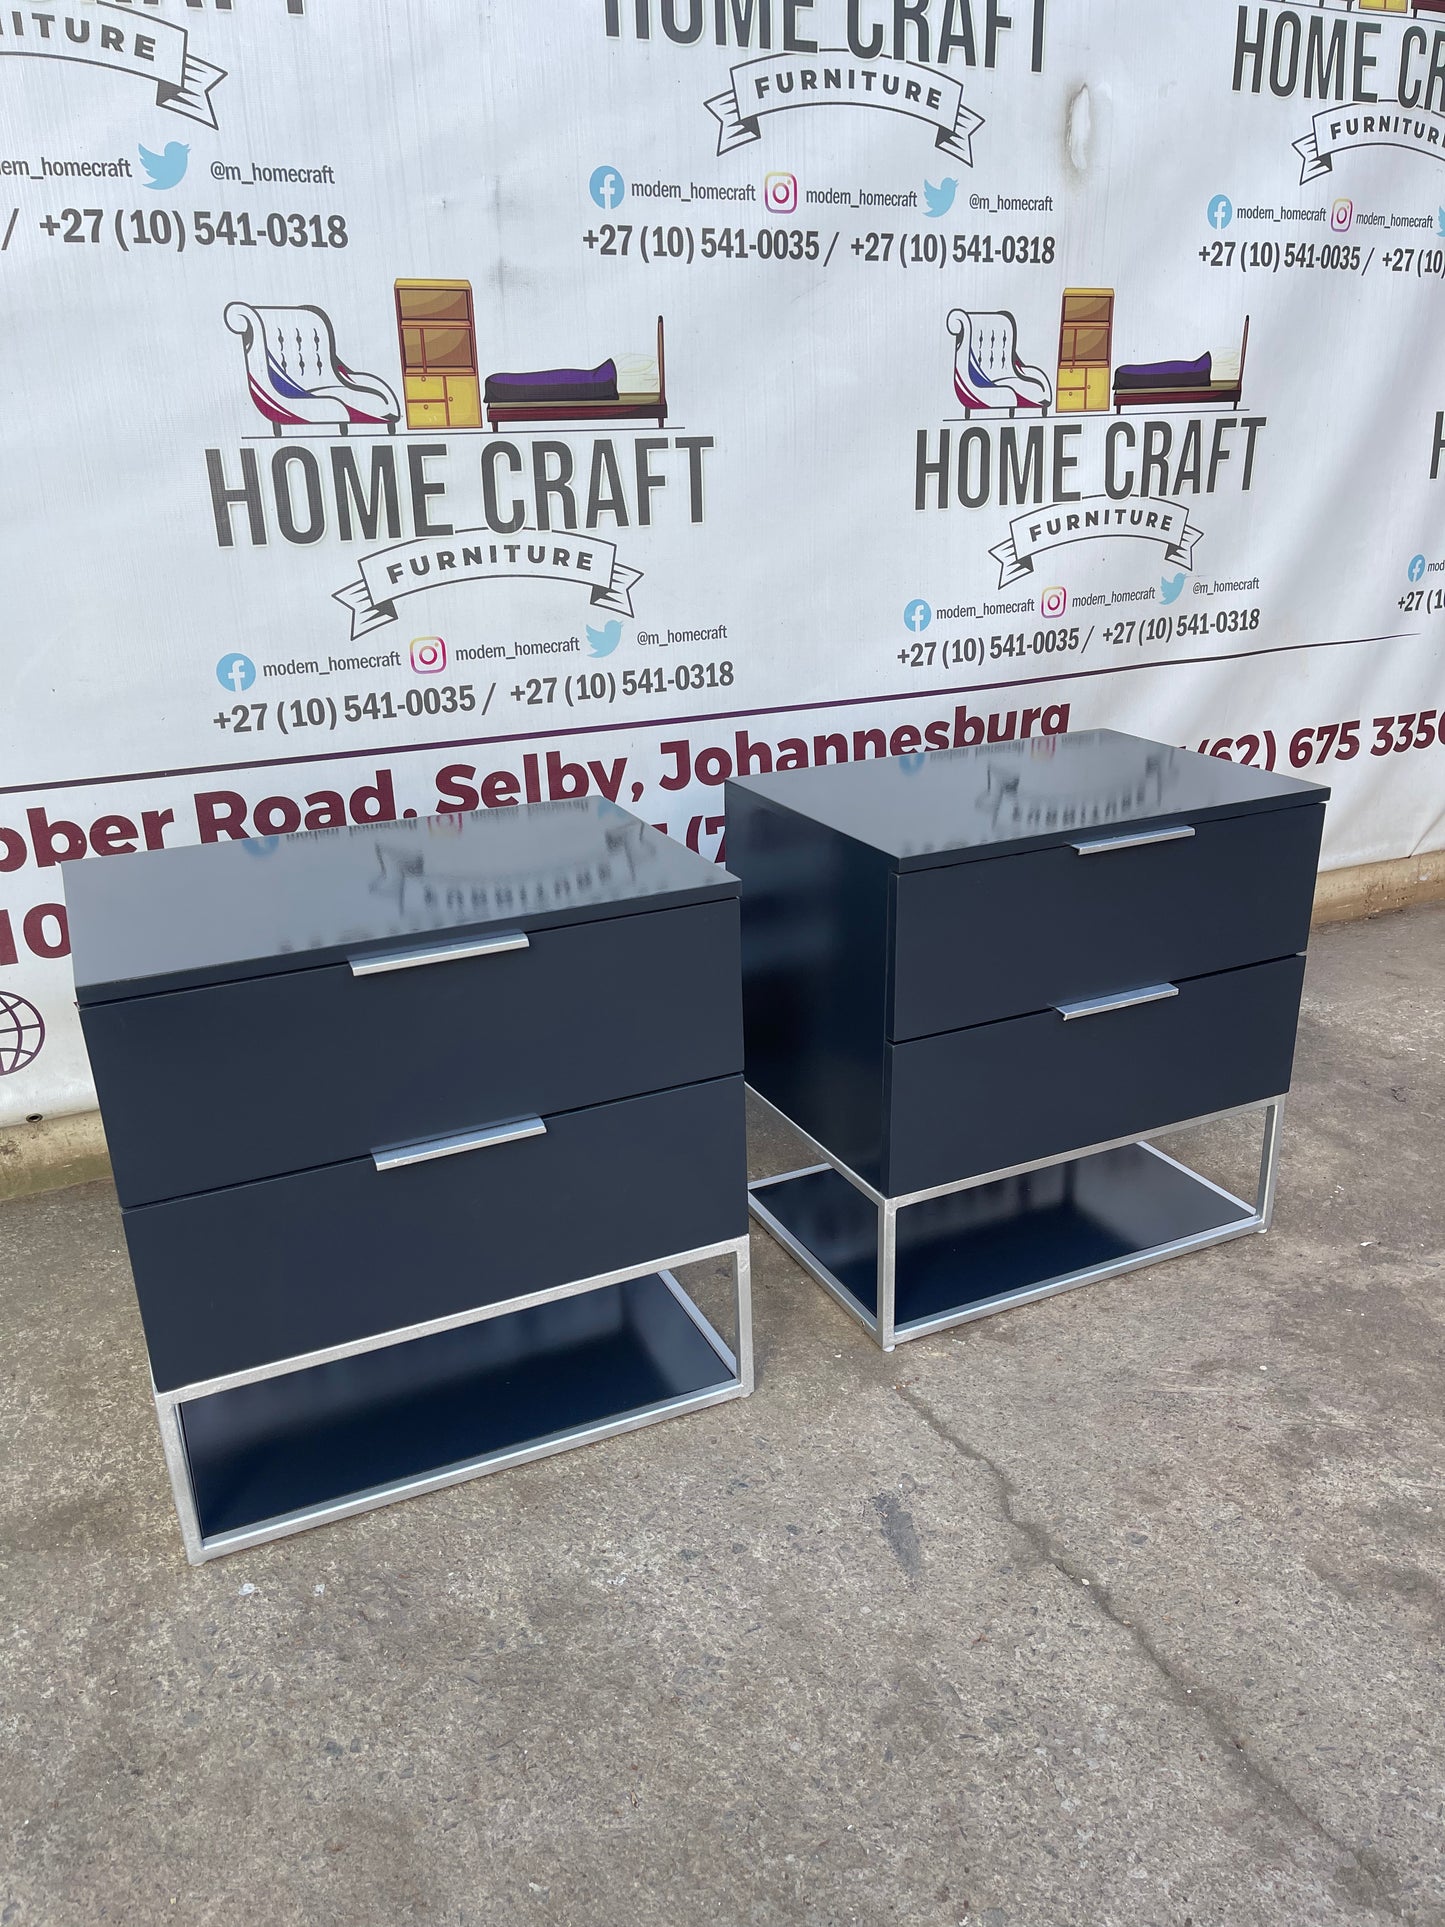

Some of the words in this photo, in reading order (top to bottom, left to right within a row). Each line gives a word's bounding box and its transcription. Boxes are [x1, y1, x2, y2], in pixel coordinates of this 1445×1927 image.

[0, 11, 156, 61] ITURE
[1232, 5, 1381, 103] HOME
[754, 68, 943, 110] FURNITURE
[1330, 115, 1445, 149] FURNITUR
[0, 156, 133, 180] ern_homecraft
[210, 161, 336, 185] @m_homecraft
[631, 181, 756, 202] modern_homecraft
[806, 188, 918, 208] modern_homecraft
[969, 193, 1054, 213] @m_homecraft
[1236, 205, 1327, 222] modern_homecraft
[1355, 212, 1434, 229] modern_homecraft
[39, 208, 104, 243] +27
[115, 209, 187, 252] (10)
[194, 211, 349, 249] 541-0318
[582, 224, 633, 256] +27
[640, 225, 695, 264] (10)
[700, 228, 820, 260] 541-0035
[851, 232, 895, 262] +27
[900, 233, 948, 269] (10)
[952, 234, 1056, 264] 541-0318
[1198, 241, 1236, 267] +27
[1240, 241, 1281, 273] (10)
[1284, 242, 1361, 270] 541-0035
[1382, 247, 1415, 272] +27
[915, 423, 1083, 511] HOME
[1105, 416, 1268, 500] CRAFT
[204, 442, 454, 549] HOME
[480, 436, 715, 535] CRAFT
[1029, 509, 1174, 542] FURNITURE
[386, 543, 595, 585] FURNITURE
[936, 599, 1036, 619] modern_homecraft
[1072, 586, 1156, 607] modern_homecraft
[1192, 577, 1260, 596] @m_homecraft
[1398, 590, 1425, 612] +27
[1427, 588, 1445, 614] (1
[262, 651, 402, 677] modern_homecraft
[455, 637, 580, 661] modern_homecraft
[636, 624, 728, 648] @m_homecraft
[897, 641, 937, 667] +27
[942, 637, 985, 670] (10)
[989, 627, 1080, 659] 541-0035
[1102, 621, 1137, 645] +27
[1138, 616, 1173, 646] (10)
[1176, 608, 1261, 638] 541-0318
[213, 702, 268, 733] +27
[277, 697, 338, 735] (10)
[344, 684, 477, 722] 541-0035
[510, 677, 558, 705] +27
[564, 672, 616, 707] (10)
[622, 660, 735, 696] 541-0318
[435, 751, 645, 815] Selby,
[659, 703, 1071, 791] Johannesburg
[1289, 719, 1361, 768] 675
